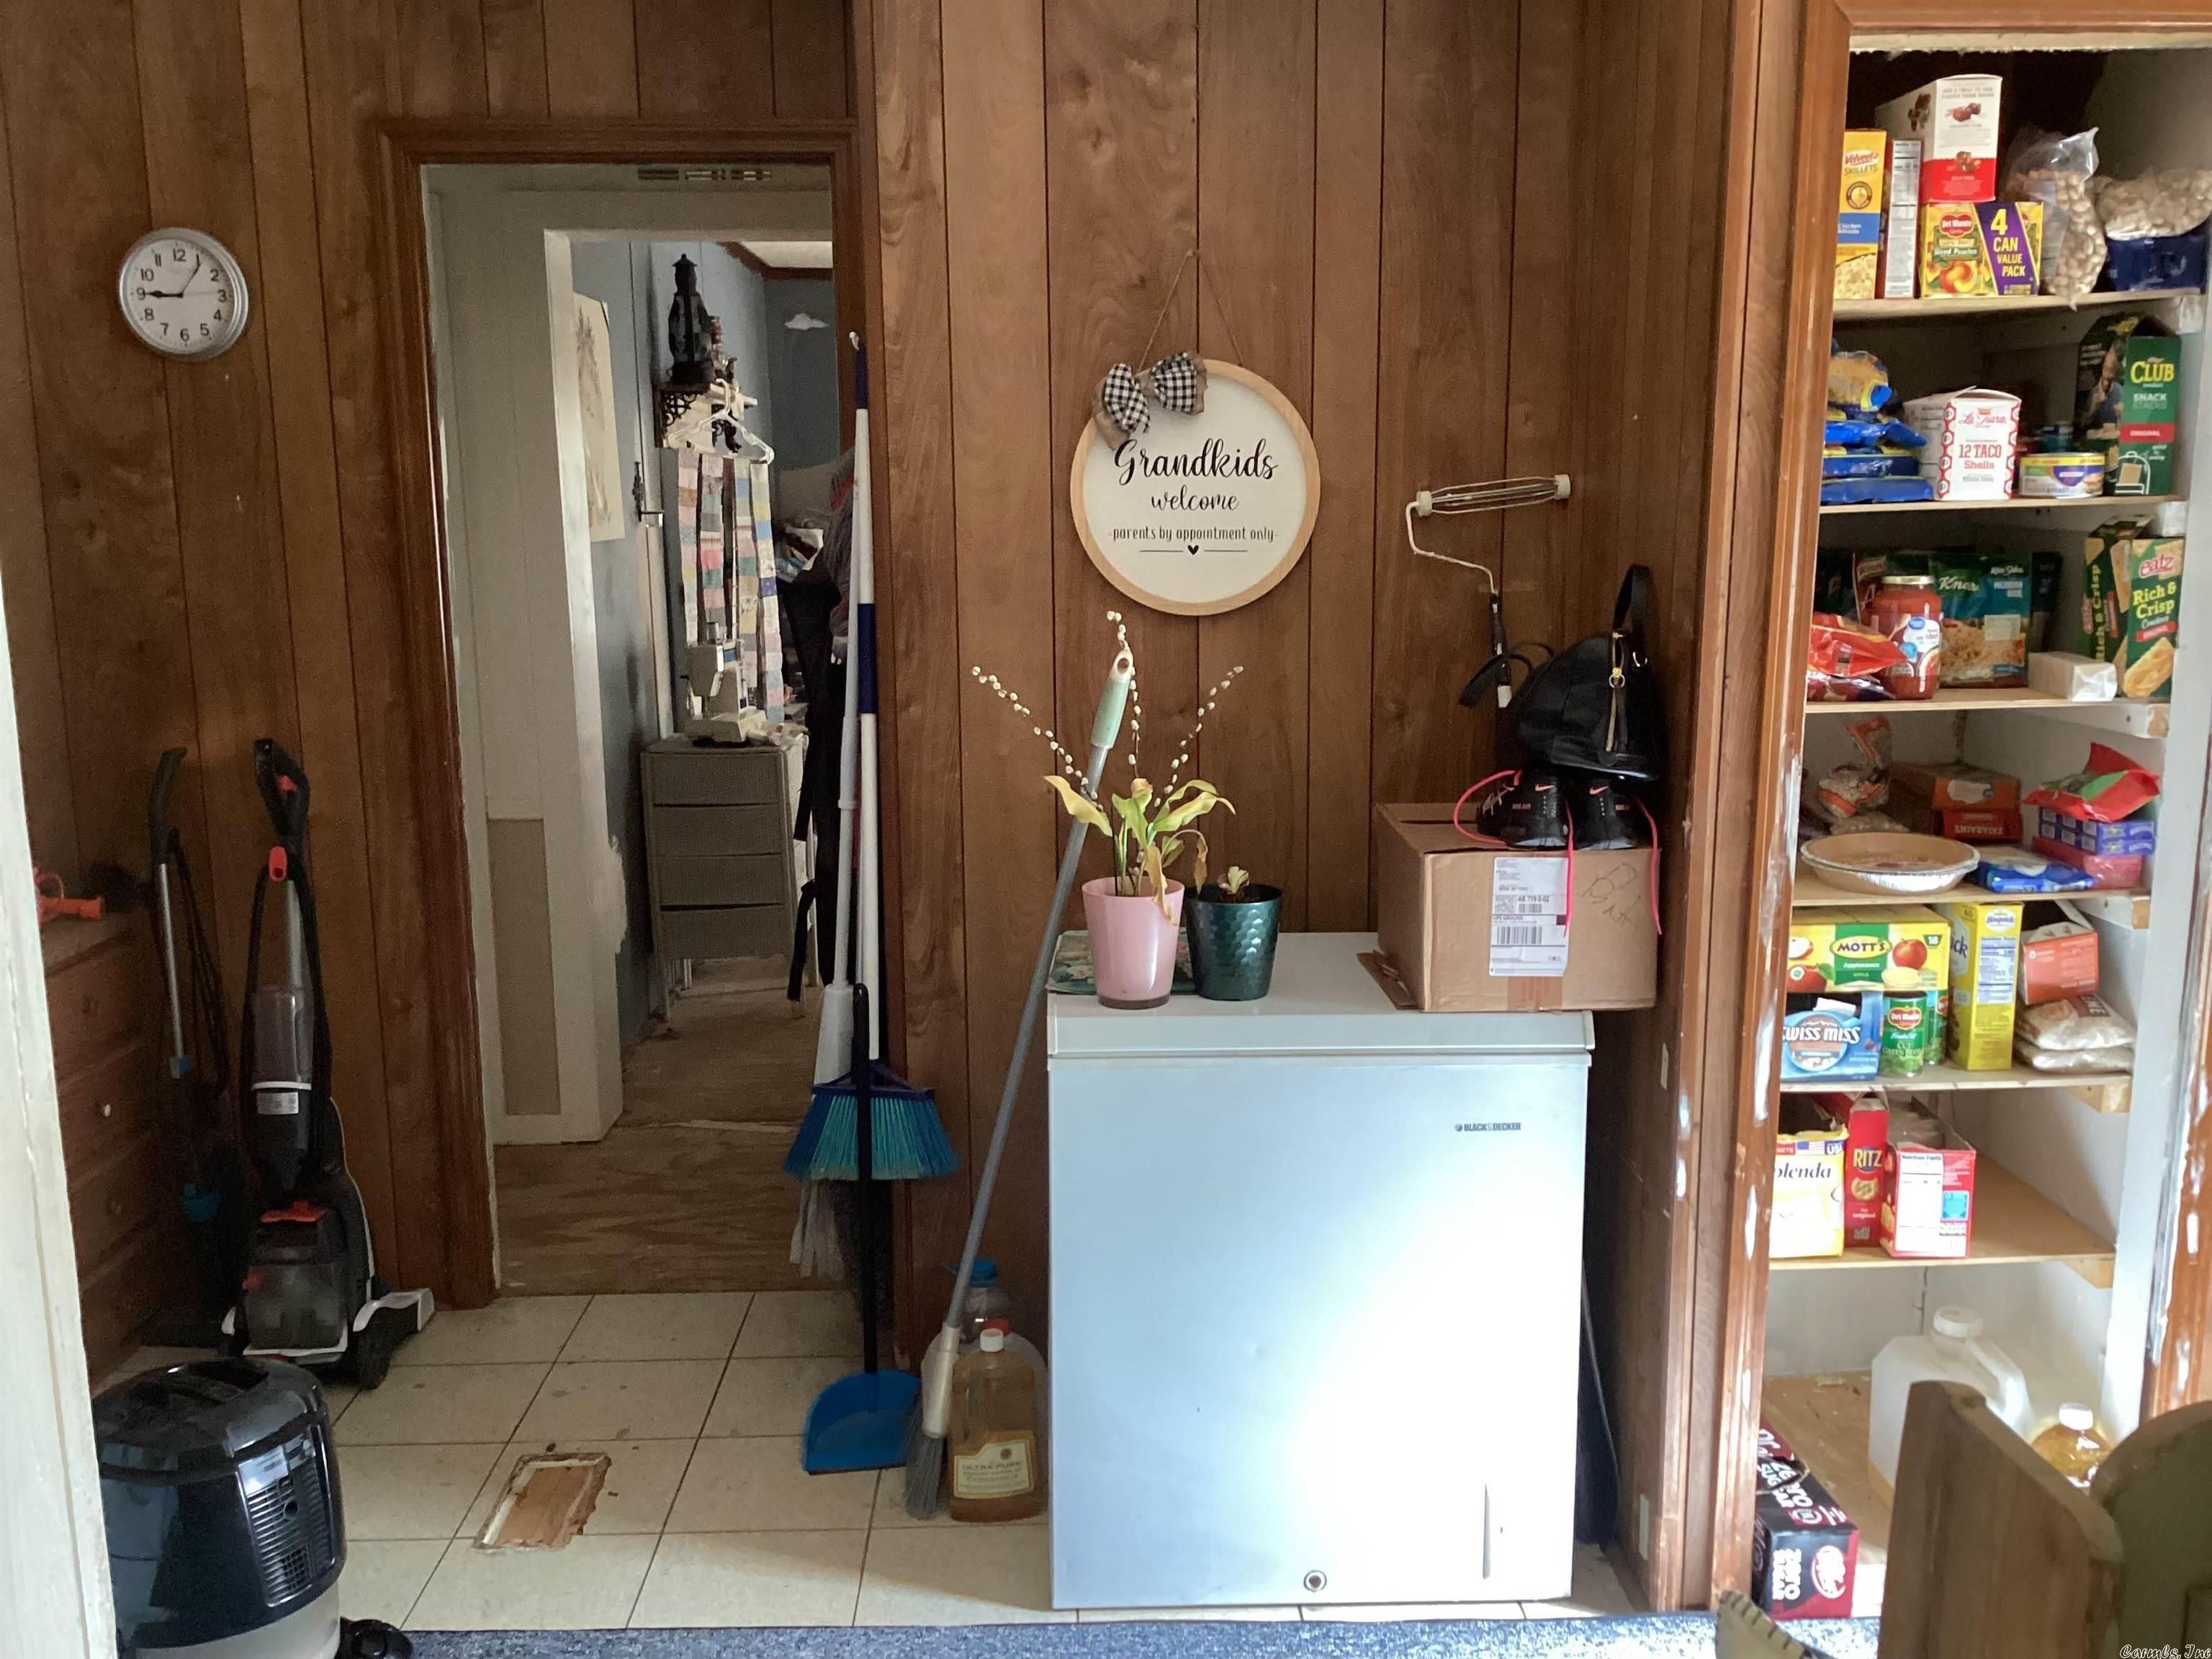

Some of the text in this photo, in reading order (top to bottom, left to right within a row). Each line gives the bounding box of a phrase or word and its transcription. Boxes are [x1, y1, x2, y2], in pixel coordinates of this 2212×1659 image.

[1844, 163, 1878, 174] SKILLETS
[1990, 208, 2008, 235] 4
[1993, 237, 2018, 252] CAN
[154, 253, 162, 266] 11
[173, 248, 186, 262] 12
[1997, 253, 2023, 264] VALUE
[140, 268, 154, 282] 10
[210, 269, 220, 282] 2
[2002, 265, 2026, 277] PACK
[136, 287, 146, 300] 9
[217, 289, 228, 302] 3
[144, 307, 155, 321] 8
[213, 309, 222, 321] 4
[160, 323, 169, 336] 7
[179, 328, 189, 341] 6
[199, 323, 210, 336] 5
[2131, 361, 2175, 384] CLUB
[2134, 392, 2167, 403] SNACK
[1959, 444, 2002, 459] 12 TACO
[1114, 438, 1279, 486] Grandkids
[1964, 460, 1995, 469] Shells
[1151, 484, 1241, 511] welcome
[1159, 526, 1172, 542] by
[1176, 526, 1246, 542] appointment
[2139, 554, 2174, 579] eatz
[2132, 580, 2177, 606] Rich &
[2136, 598, 2175, 619] Crisp
[1518, 894, 1526, 903] AR
[1836, 942, 1886, 952] MOTT'S
[1927, 936, 1939, 945] 18
[1823, 1026, 1861, 1045] MISS
[1853, 1148, 1884, 1169] RITZ
